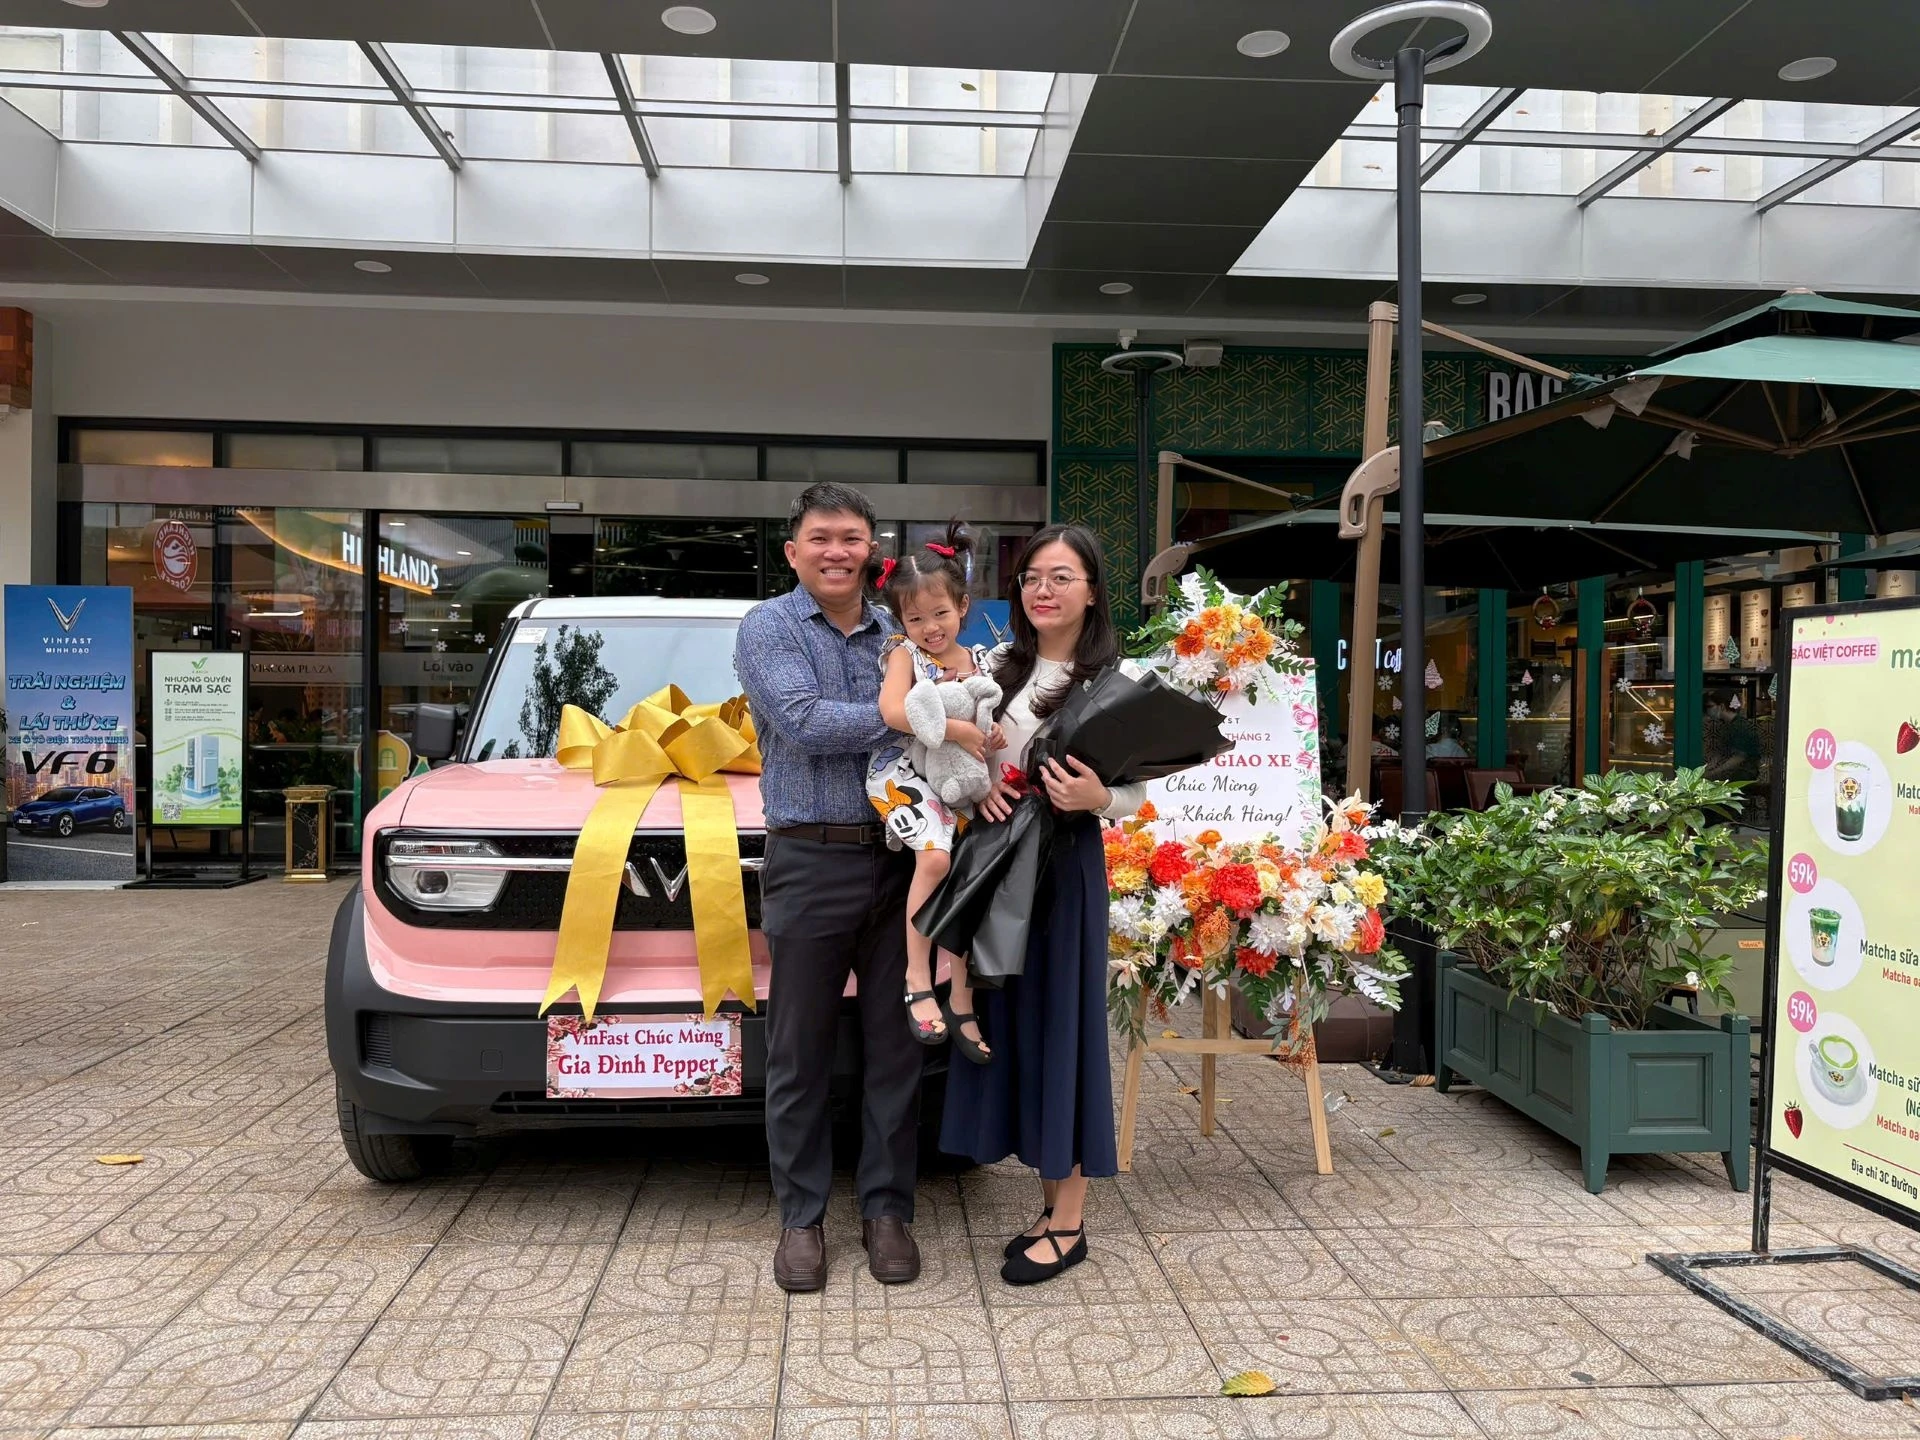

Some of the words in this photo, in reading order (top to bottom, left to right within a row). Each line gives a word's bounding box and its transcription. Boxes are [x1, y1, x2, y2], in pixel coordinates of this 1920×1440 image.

[342, 530, 439, 590] HIHLANDS
[43, 637, 92, 645] VINFAST
[1812, 643, 1835, 662] VIỆT
[1836, 643, 1877, 658] COFFEE
[299, 663, 333, 674] PLAZA
[9, 671, 52, 690] TRẢI
[54, 672, 125, 693] NGHIỆM
[164, 684, 202, 696] TRẠM
[60, 695, 76, 710] &
[19, 712, 50, 731] LÁI
[91, 716, 118, 731] XE
[1225, 731, 1262, 742] THÁNG
[1264, 733, 1271, 742] 2
[1807, 738, 1833, 760] 49k
[1214, 754, 1262, 767] GIAO
[1267, 754, 1292, 767] XE
[1165, 774, 1207, 792] Chúc
[1211, 774, 1260, 796] Mừng
[1182, 804, 1235, 822] Khách
[1241, 804, 1293, 827] Hàng!
[1790, 861, 1815, 886] 59k
[1860, 939, 1896, 961] Matcha
[1899, 948, 1919, 966] sữa
[1882, 967, 1911, 985] Matcha
[1790, 997, 1815, 1025] 59k
[571, 1029, 630, 1046] VinFast
[634, 1029, 674, 1045] Chúc
[678, 1028, 724, 1047] Mừng
[557, 1053, 591, 1075] Gia
[597, 1053, 646, 1074] Đình
[653, 1053, 719, 1080] Pepper
[1868, 1062, 1905, 1088] Matcha
[1876, 1114, 1907, 1137] Matcha
[1851, 1158, 1864, 1176] Địa
[1879, 1170, 1890, 1185] 3C
[1891, 1175, 1918, 1200] Đường
